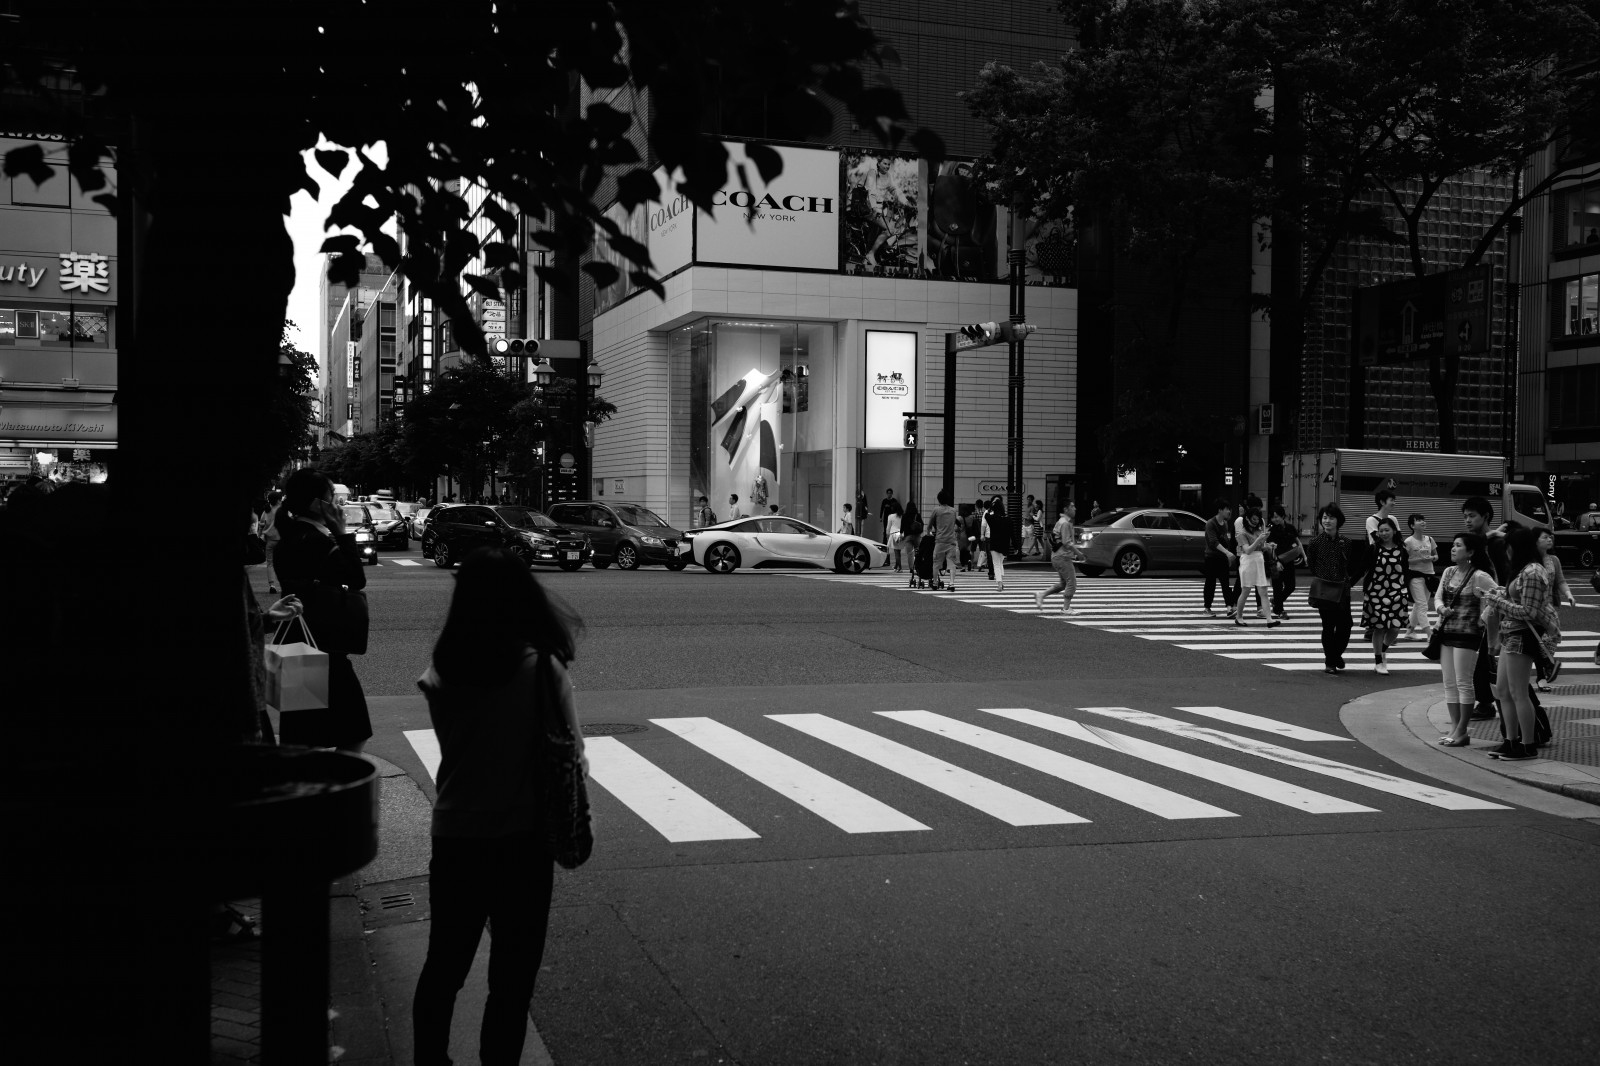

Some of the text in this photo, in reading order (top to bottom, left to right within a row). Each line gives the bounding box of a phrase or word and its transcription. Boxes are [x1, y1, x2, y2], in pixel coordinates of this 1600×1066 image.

[650, 194, 690, 232] COACH
[769, 213, 797, 222] YORK
[59, 251, 111, 294] 薬
[1405, 440, 1440, 449] HERME
[982, 484, 1016, 492] COA
[1547, 474, 1557, 498] Sony
